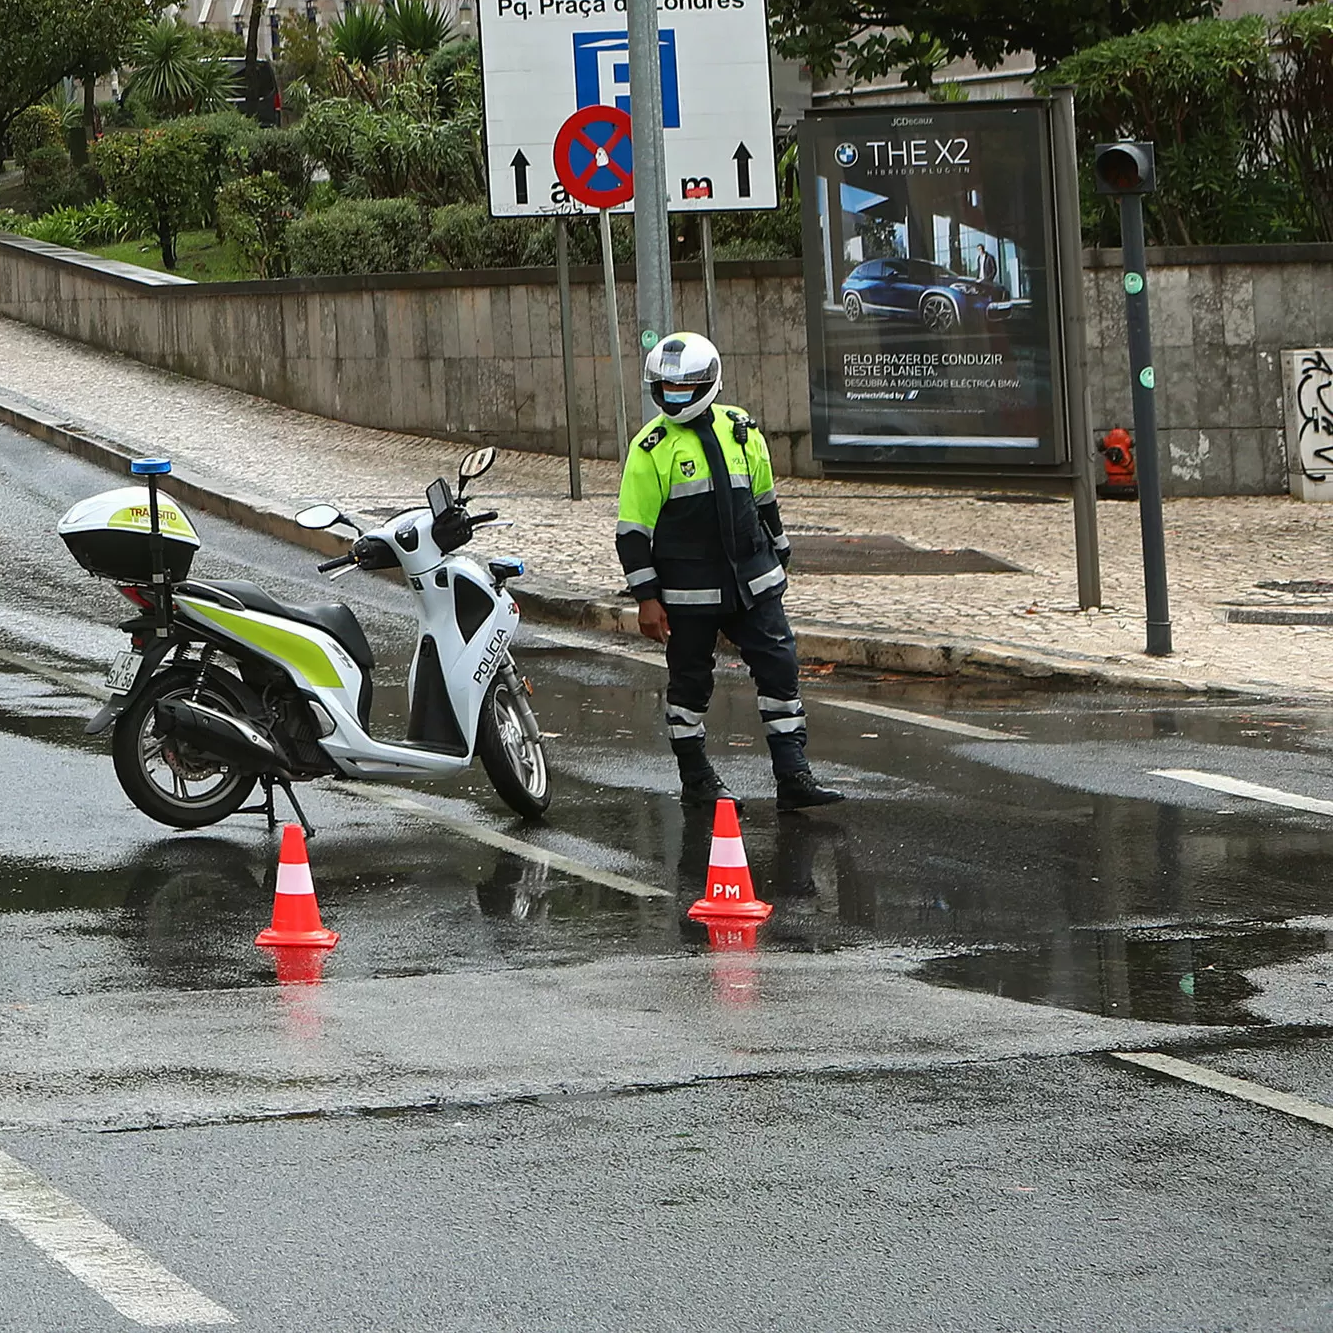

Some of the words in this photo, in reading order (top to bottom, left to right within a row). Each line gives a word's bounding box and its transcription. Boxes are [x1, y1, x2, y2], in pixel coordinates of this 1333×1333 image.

[891, 117, 934, 127] JCDecaux
[866, 140, 928, 167] THE
[934, 138, 971, 165] X2
[682, 177, 714, 200] m
[843, 354, 873, 365] PELO
[875, 354, 921, 365] PRAZER
[923, 354, 939, 365] DE
[941, 353, 1003, 365] CONDUZIR
[844, 366, 880, 376] NESTE
[883, 365, 938, 377] PLANETA.
[844, 378, 889, 388] DESCUBRA
[889, 378, 896, 388] A
[897, 378, 949, 388] MOBILIDADE
[895, 391, 905, 401] by
[712, 883, 741, 900] PM
